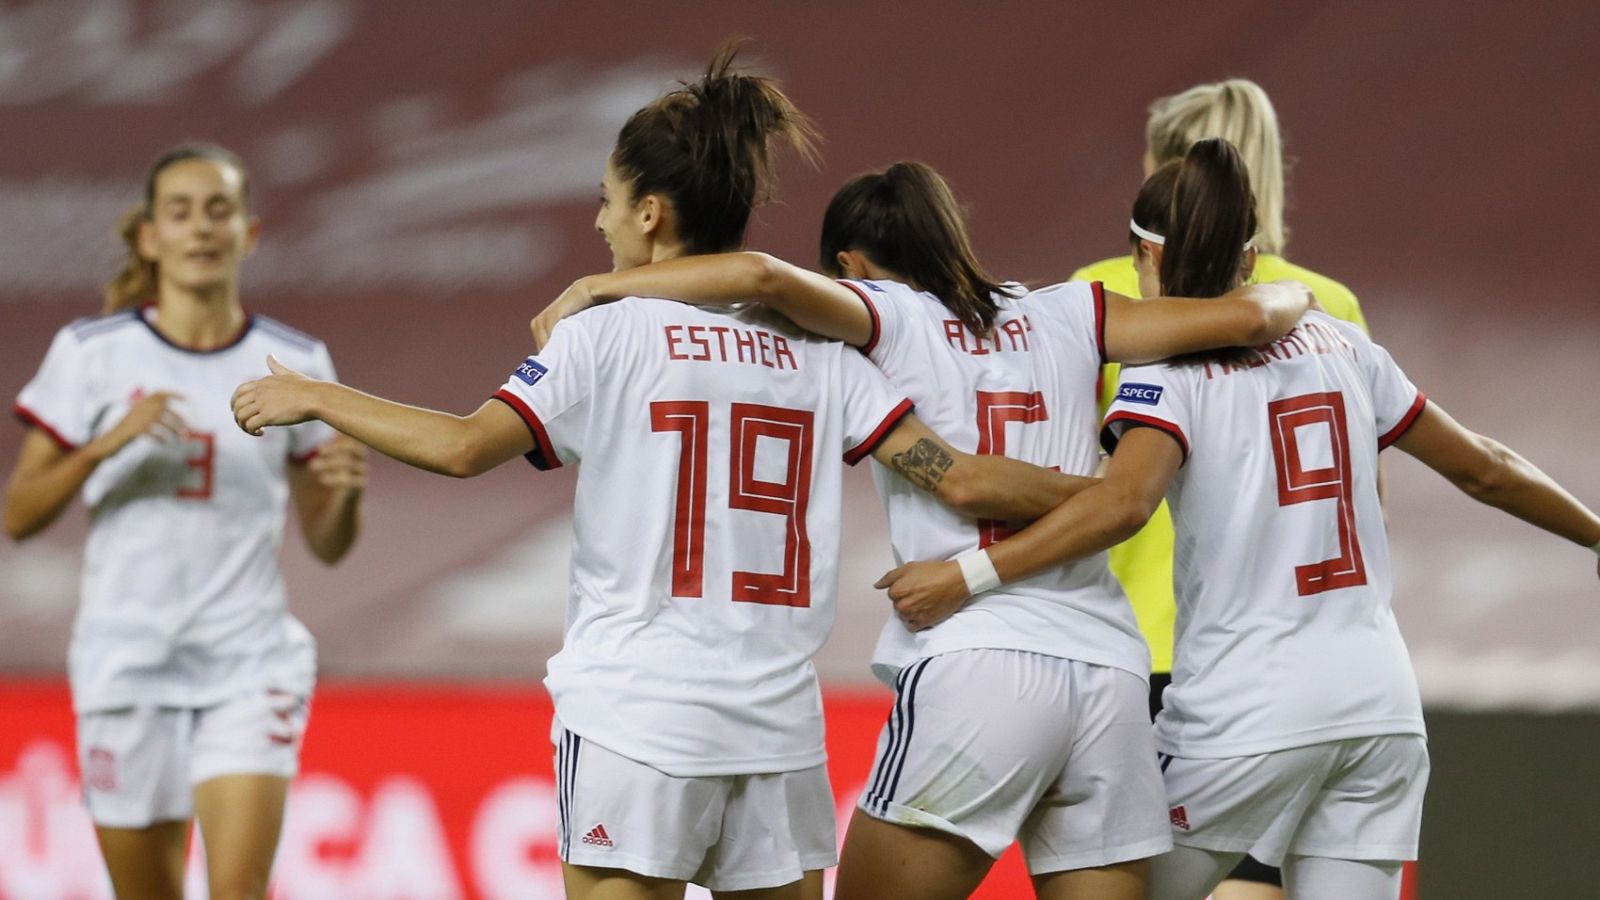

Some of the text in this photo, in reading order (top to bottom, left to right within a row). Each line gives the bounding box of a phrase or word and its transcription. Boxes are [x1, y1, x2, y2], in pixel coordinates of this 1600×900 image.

[665, 326, 798, 370] ESTHER
[175, 431, 214, 501] 3
[1267, 391, 1368, 597] 9
[650, 400, 815, 608] 19
[582, 836, 614, 847] adidas
